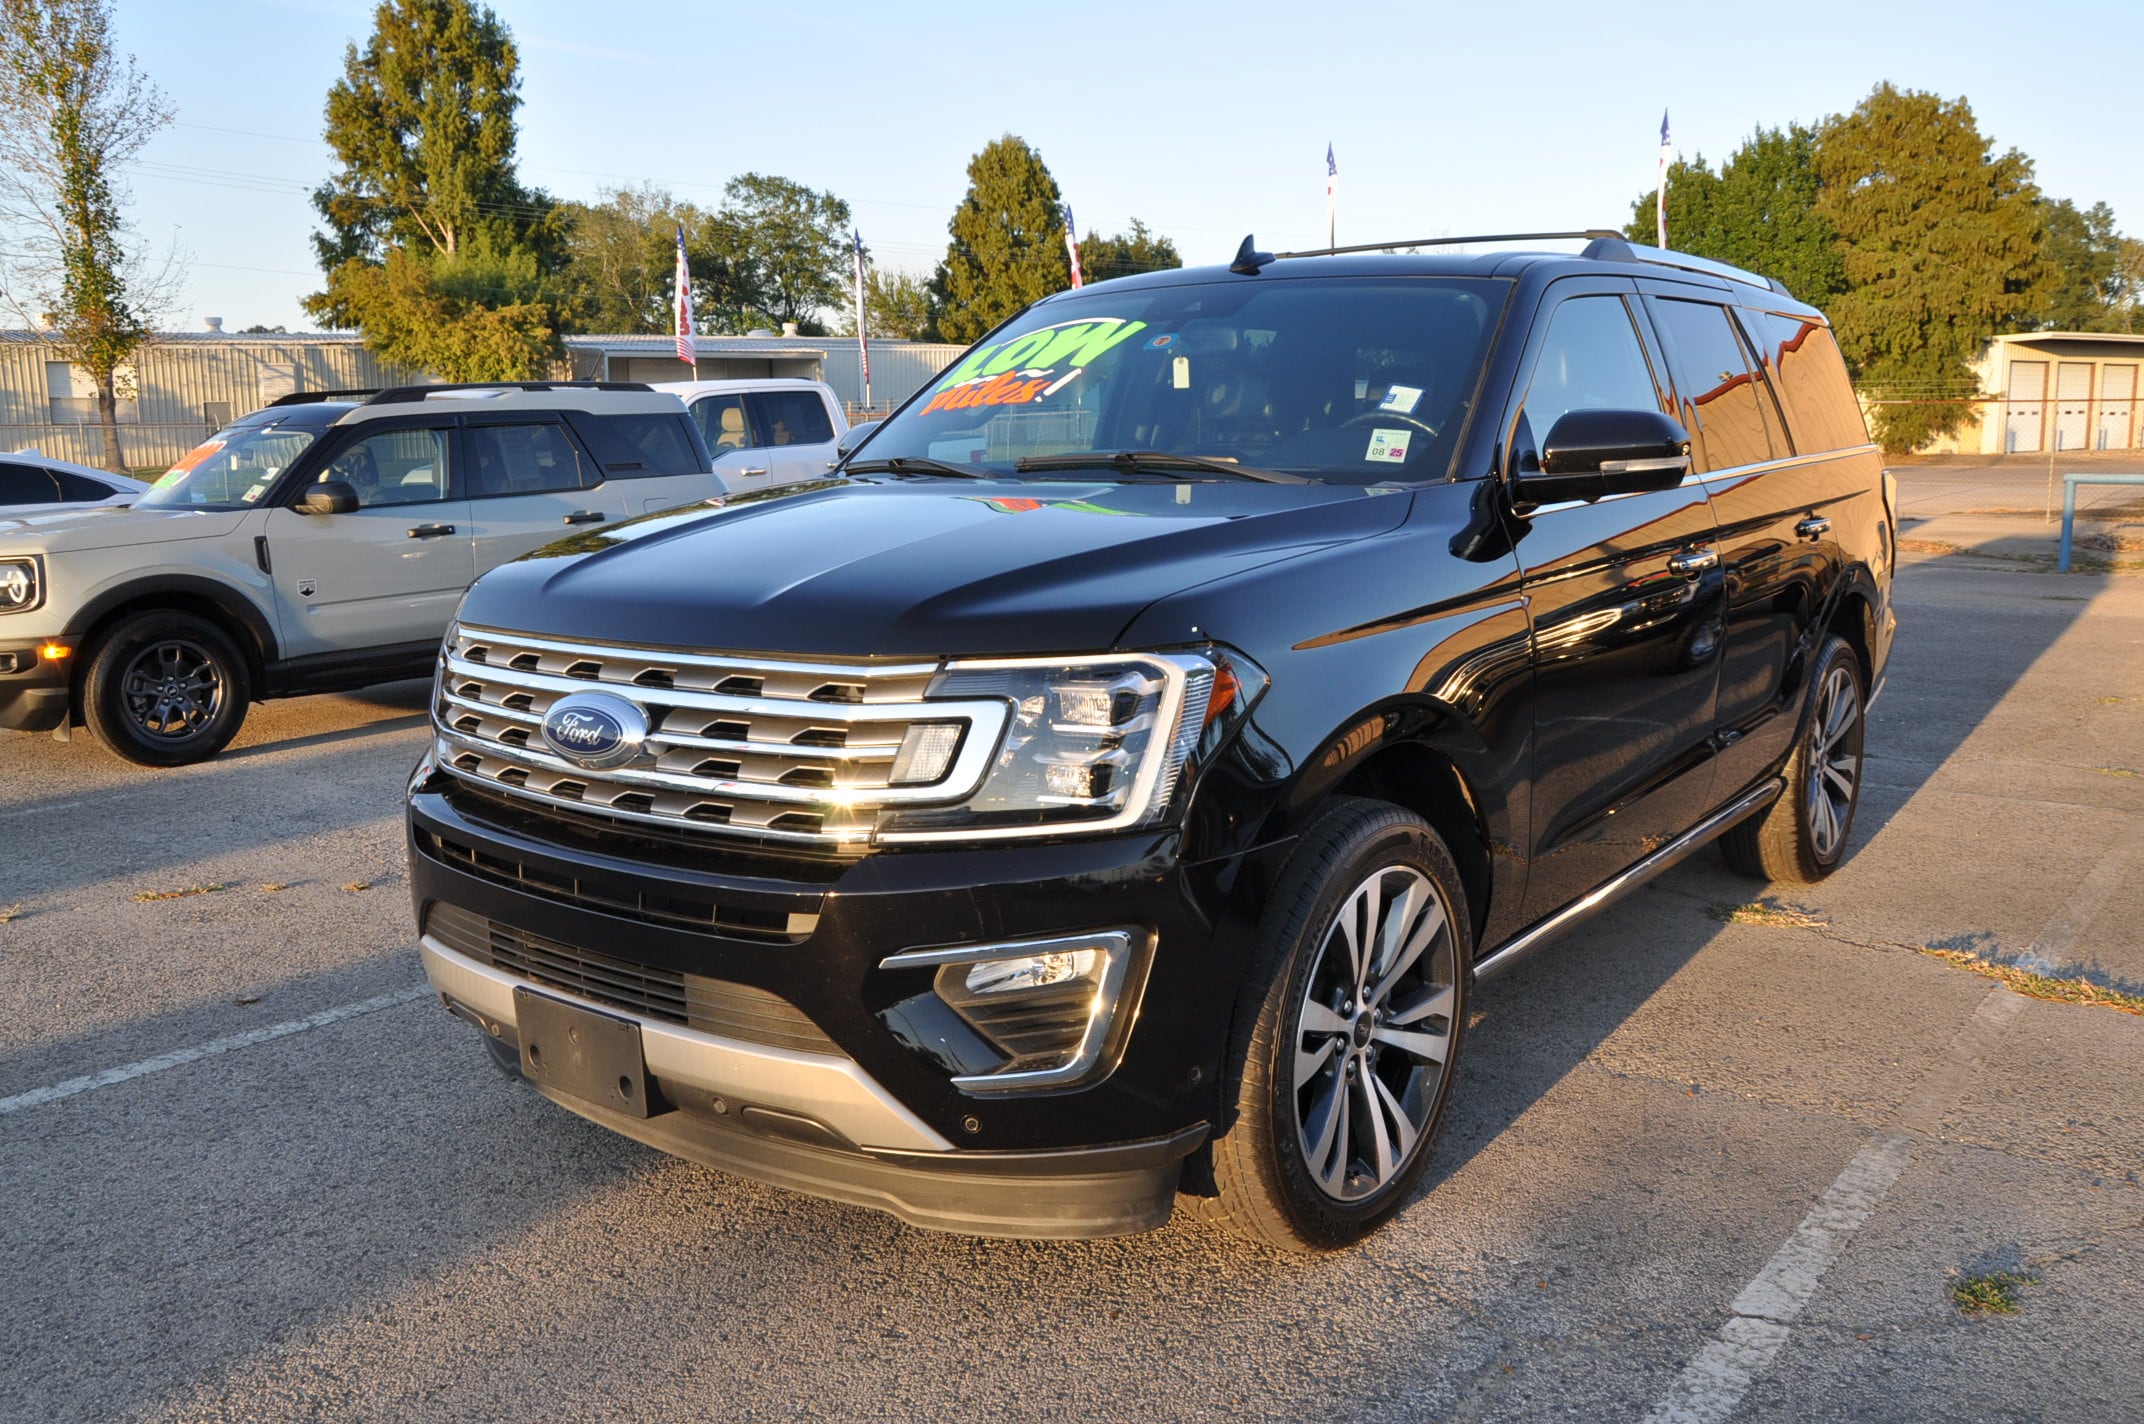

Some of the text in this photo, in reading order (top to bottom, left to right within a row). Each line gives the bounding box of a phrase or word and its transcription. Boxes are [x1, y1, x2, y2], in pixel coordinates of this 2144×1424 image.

[936, 319, 1148, 393] LOW
[1372, 447, 1403, 457] 08 25
[557, 712, 603, 745] Ford
